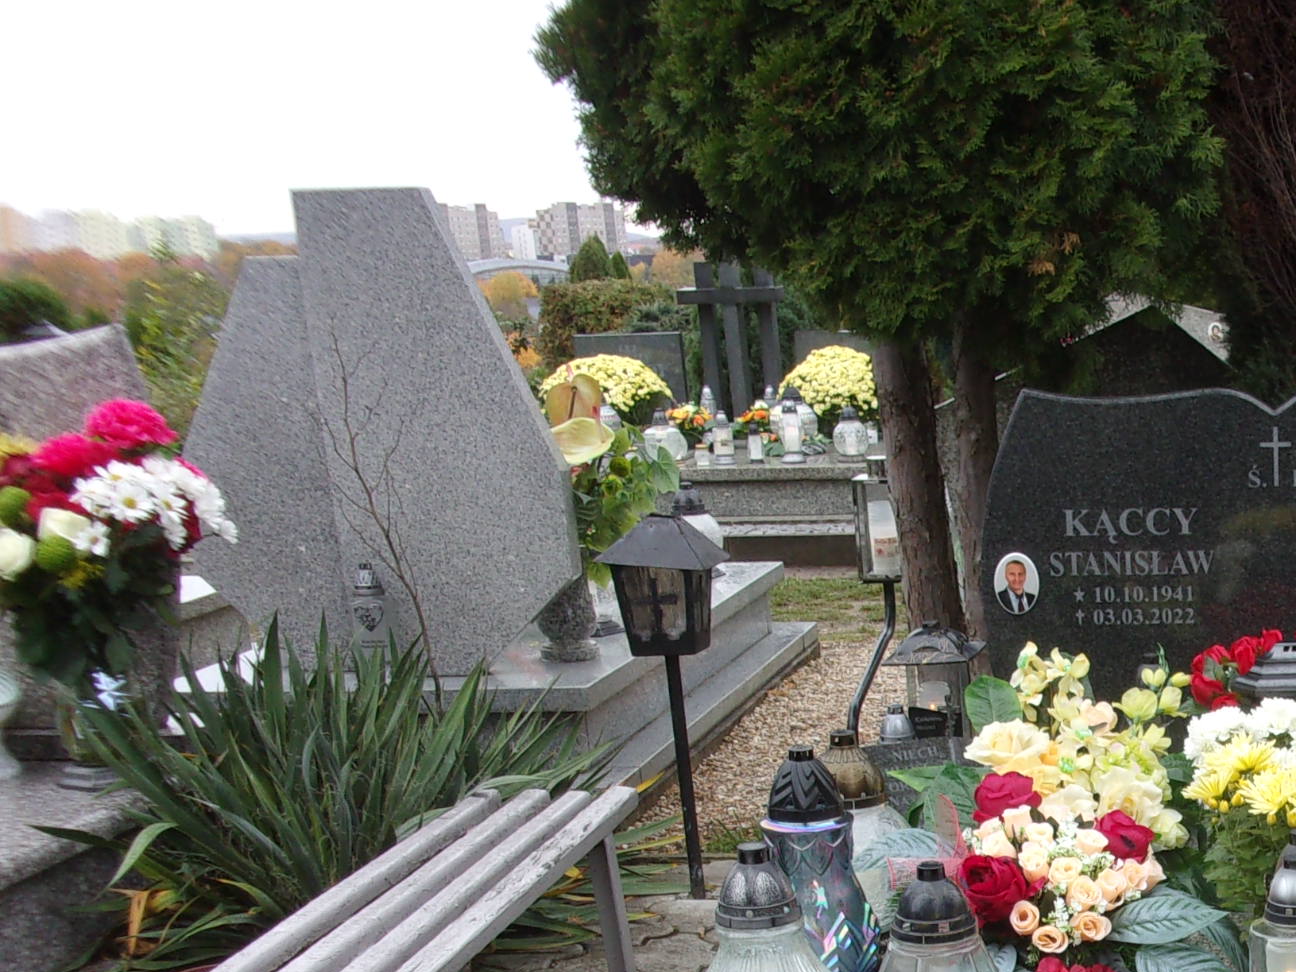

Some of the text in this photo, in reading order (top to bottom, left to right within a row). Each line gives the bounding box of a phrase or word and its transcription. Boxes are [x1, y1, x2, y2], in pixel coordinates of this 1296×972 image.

[1062, 507, 1198, 544] KĄCCY
[1049, 550, 1214, 577] STANISŁAW
[1093, 585, 1194, 603] 10.10.1941
[1092, 607, 1196, 626] 03.03.2022
